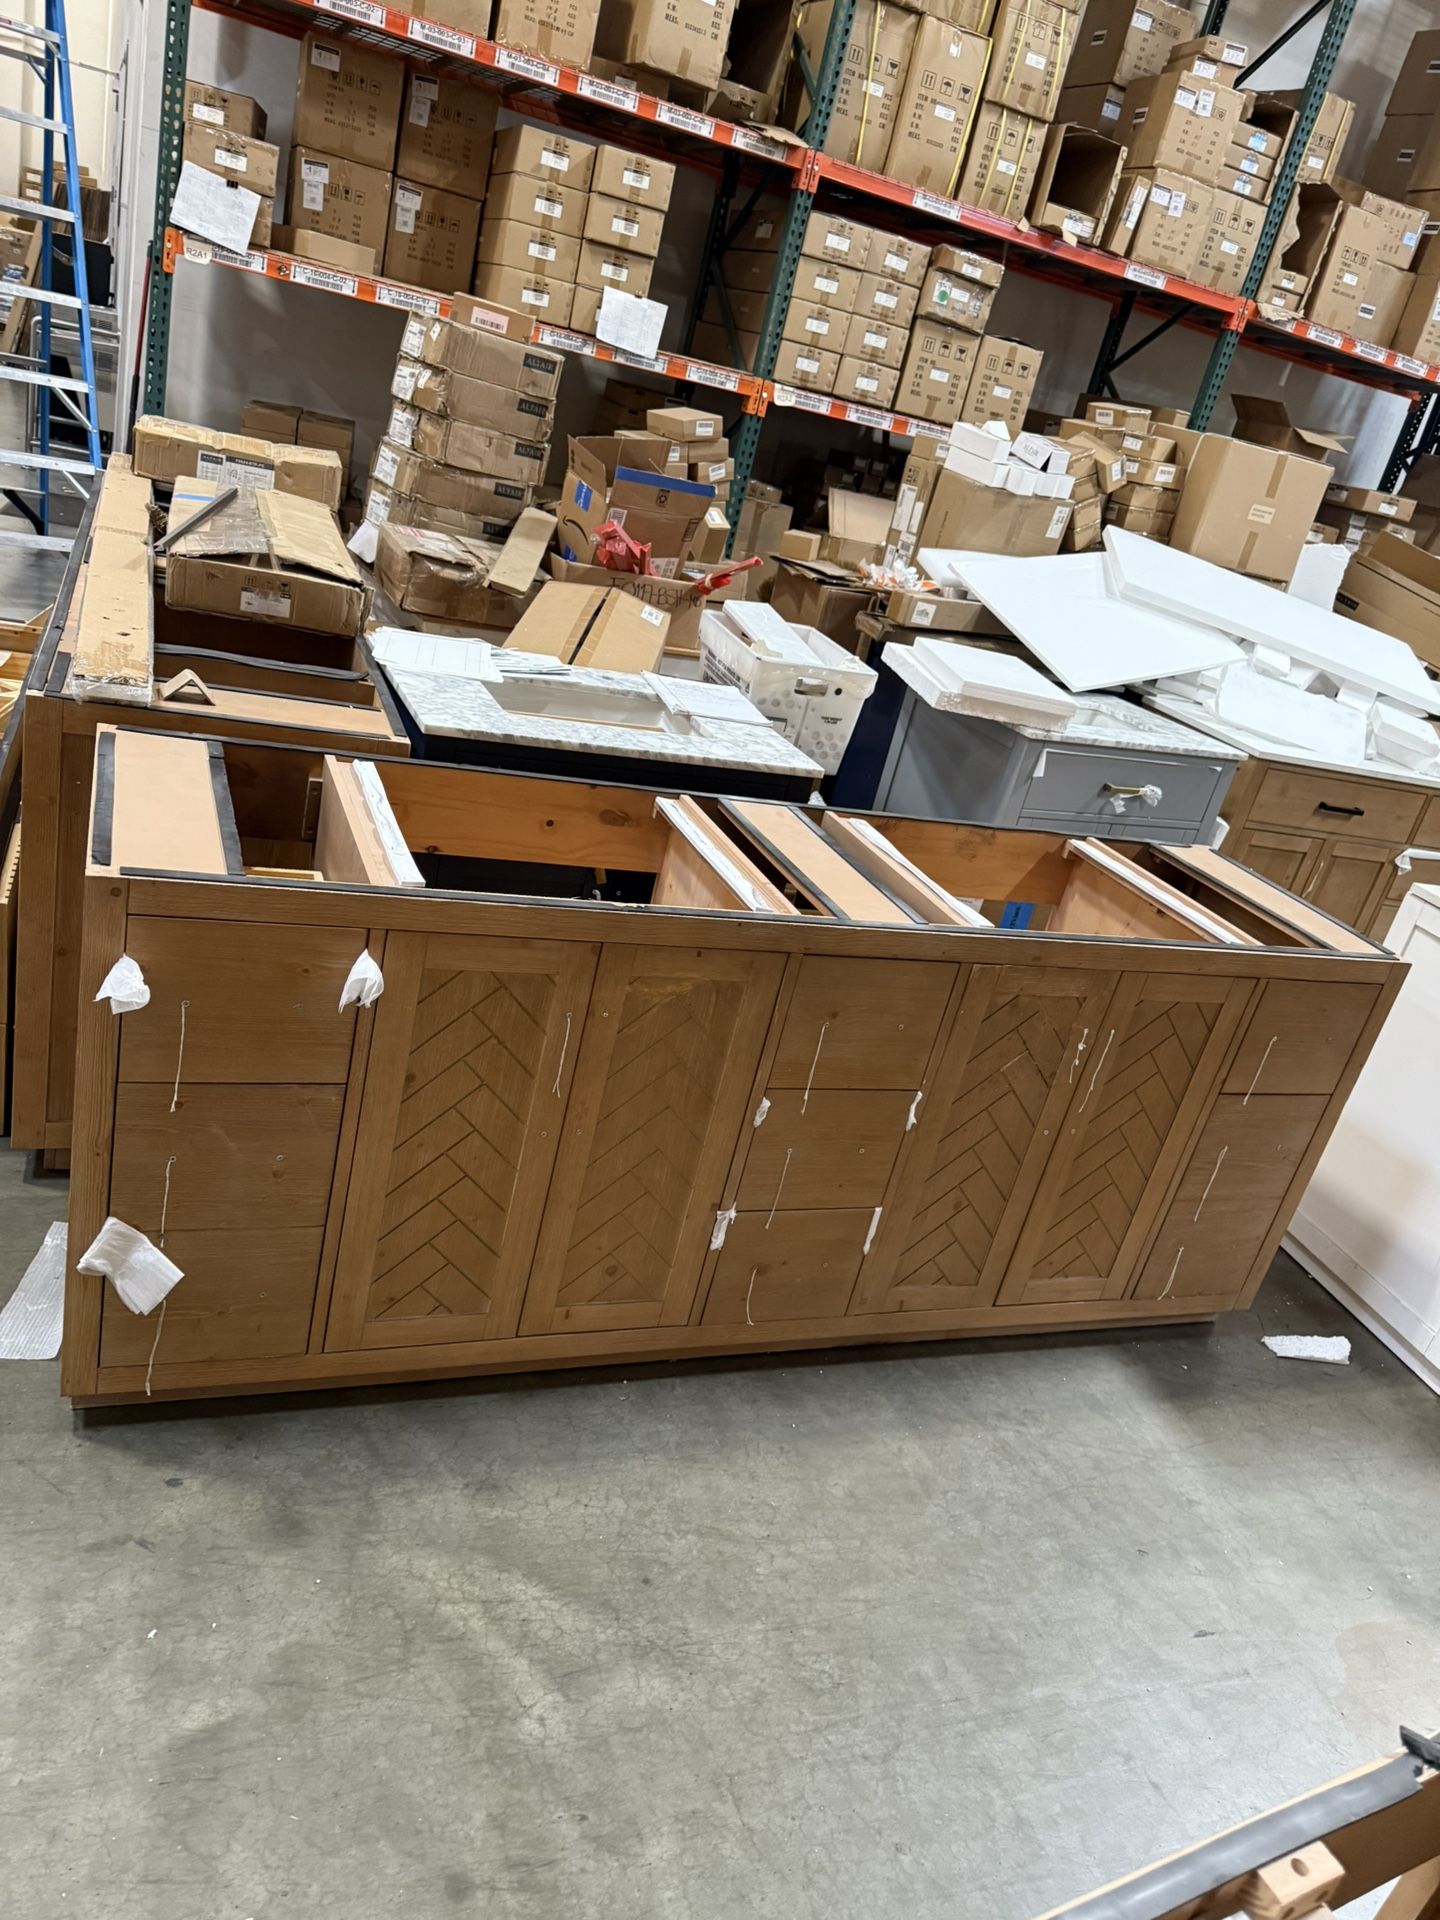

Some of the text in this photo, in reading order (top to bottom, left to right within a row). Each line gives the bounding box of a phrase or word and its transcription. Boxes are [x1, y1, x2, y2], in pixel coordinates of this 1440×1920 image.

[186, 247, 208, 259] R2A1
[526, 356, 555, 372] ALTAIR
[520, 401, 546, 416] ALTAIR
[496, 485, 523, 498] ALTAIR
